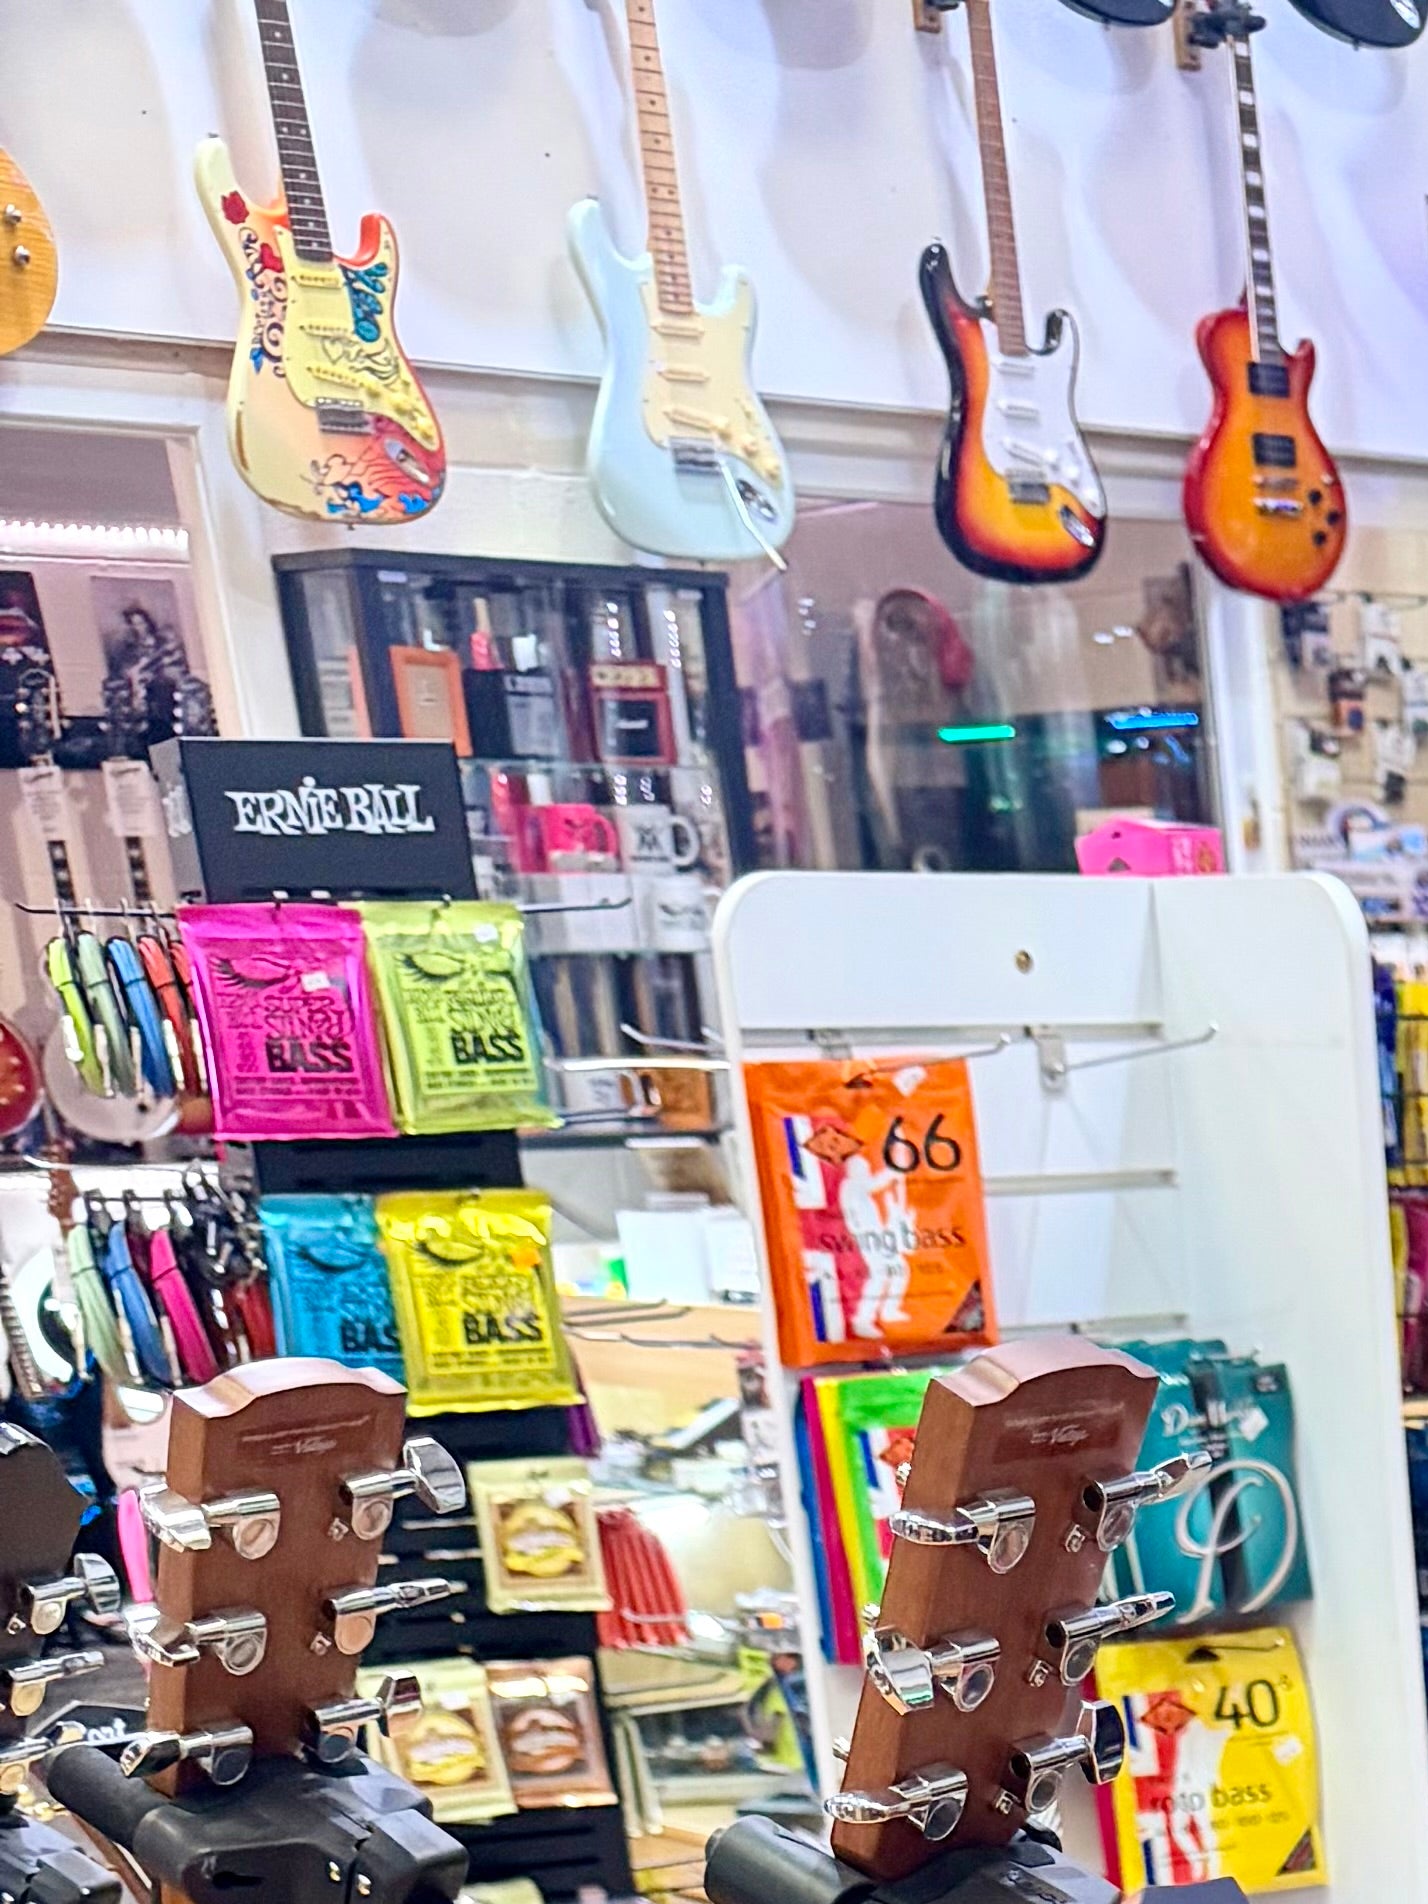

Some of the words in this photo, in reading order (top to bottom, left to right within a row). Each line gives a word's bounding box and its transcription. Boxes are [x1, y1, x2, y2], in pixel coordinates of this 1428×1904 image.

[224, 776, 344, 837] ERNIE
[345, 782, 436, 837] BALL
[264, 1036, 355, 1075] BASS
[450, 1029, 525, 1067] BASS
[881, 1112, 963, 1174] 66
[900, 1220, 967, 1250] bass
[460, 1310, 544, 1346] BASS
[1213, 1678, 1279, 1730] 40
